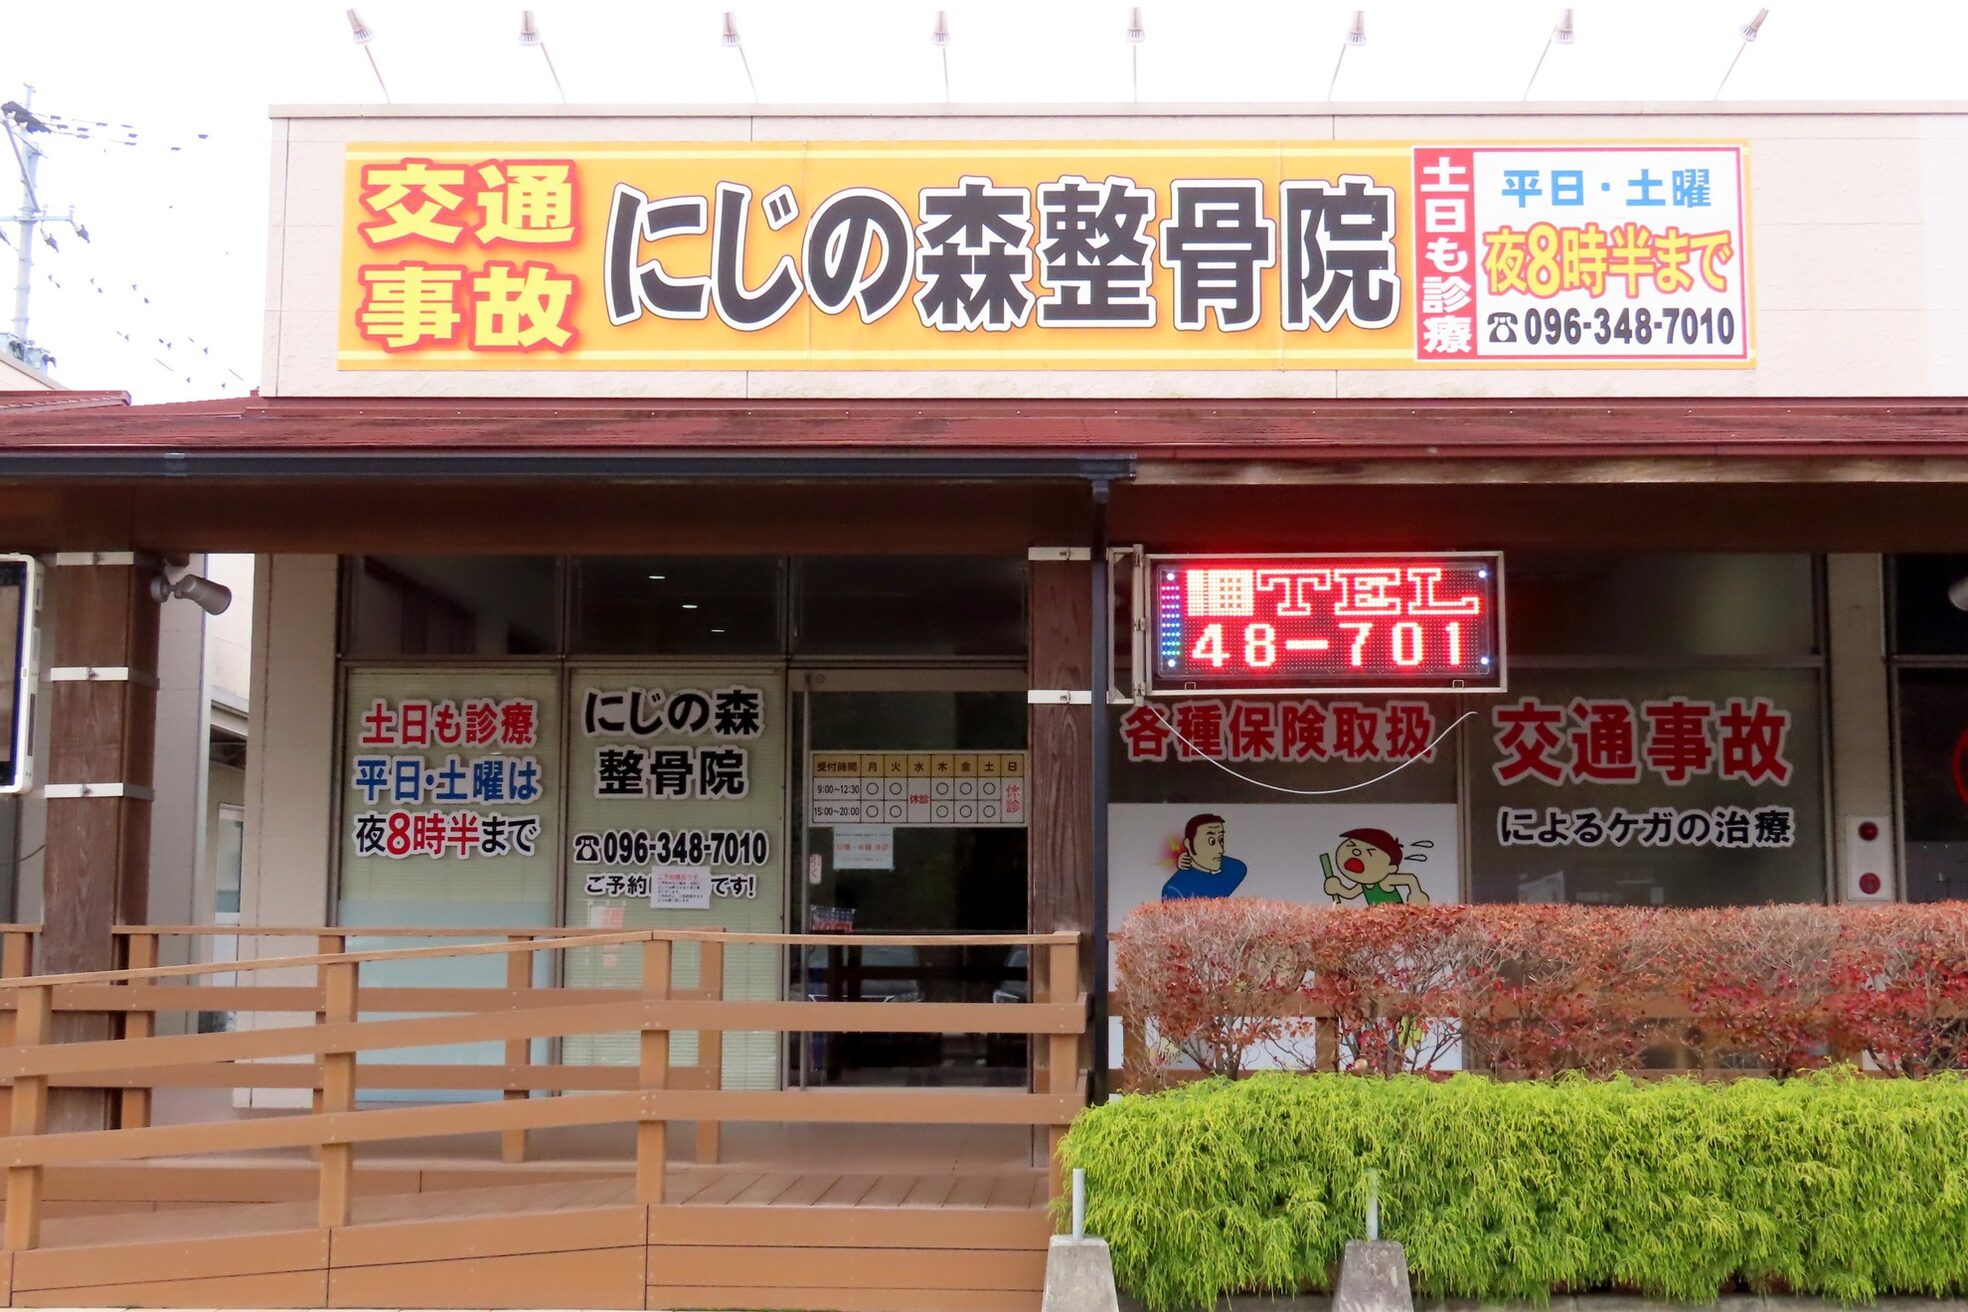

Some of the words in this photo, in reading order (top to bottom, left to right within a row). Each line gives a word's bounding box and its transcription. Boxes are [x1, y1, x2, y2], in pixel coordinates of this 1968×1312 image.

[362, 159, 576, 246] 交通
[1502, 168, 1712, 209] 平日・土曜
[604, 178, 1402, 331] にじの森整骨院
[1420, 156, 1473, 354] 土日も診療
[1483, 223, 1733, 298] 夜8時半まで
[360, 261, 576, 351] 事故
[1524, 307, 1735, 346] 096-348-7010
[1256, 568, 1481, 616] TEL
[1191, 621, 1462, 668] 48-701
[361, 702, 535, 746] 土日も診療
[585, 689, 761, 737] にじの森
[1124, 704, 1435, 760] 各種保険取扱
[1494, 701, 1790, 782] 交通事故
[355, 757, 541, 802] 平日・土曜は
[597, 748, 746, 797] 整骨院
[817, 761, 858, 773] 受付時間
[867, 761, 877, 773] 月
[891, 761, 901, 773] 火
[914, 761, 924, 773] 水
[938, 761, 948, 773] 木
[961, 761, 971, 773] 金
[984, 761, 994, 773] 土
[1008, 761, 1017, 773] 日
[356, 810, 537, 857] 夜8時半まで
[603, 831, 768, 864] 096-348-7010
[1500, 809, 1792, 845] によるケガの治療
